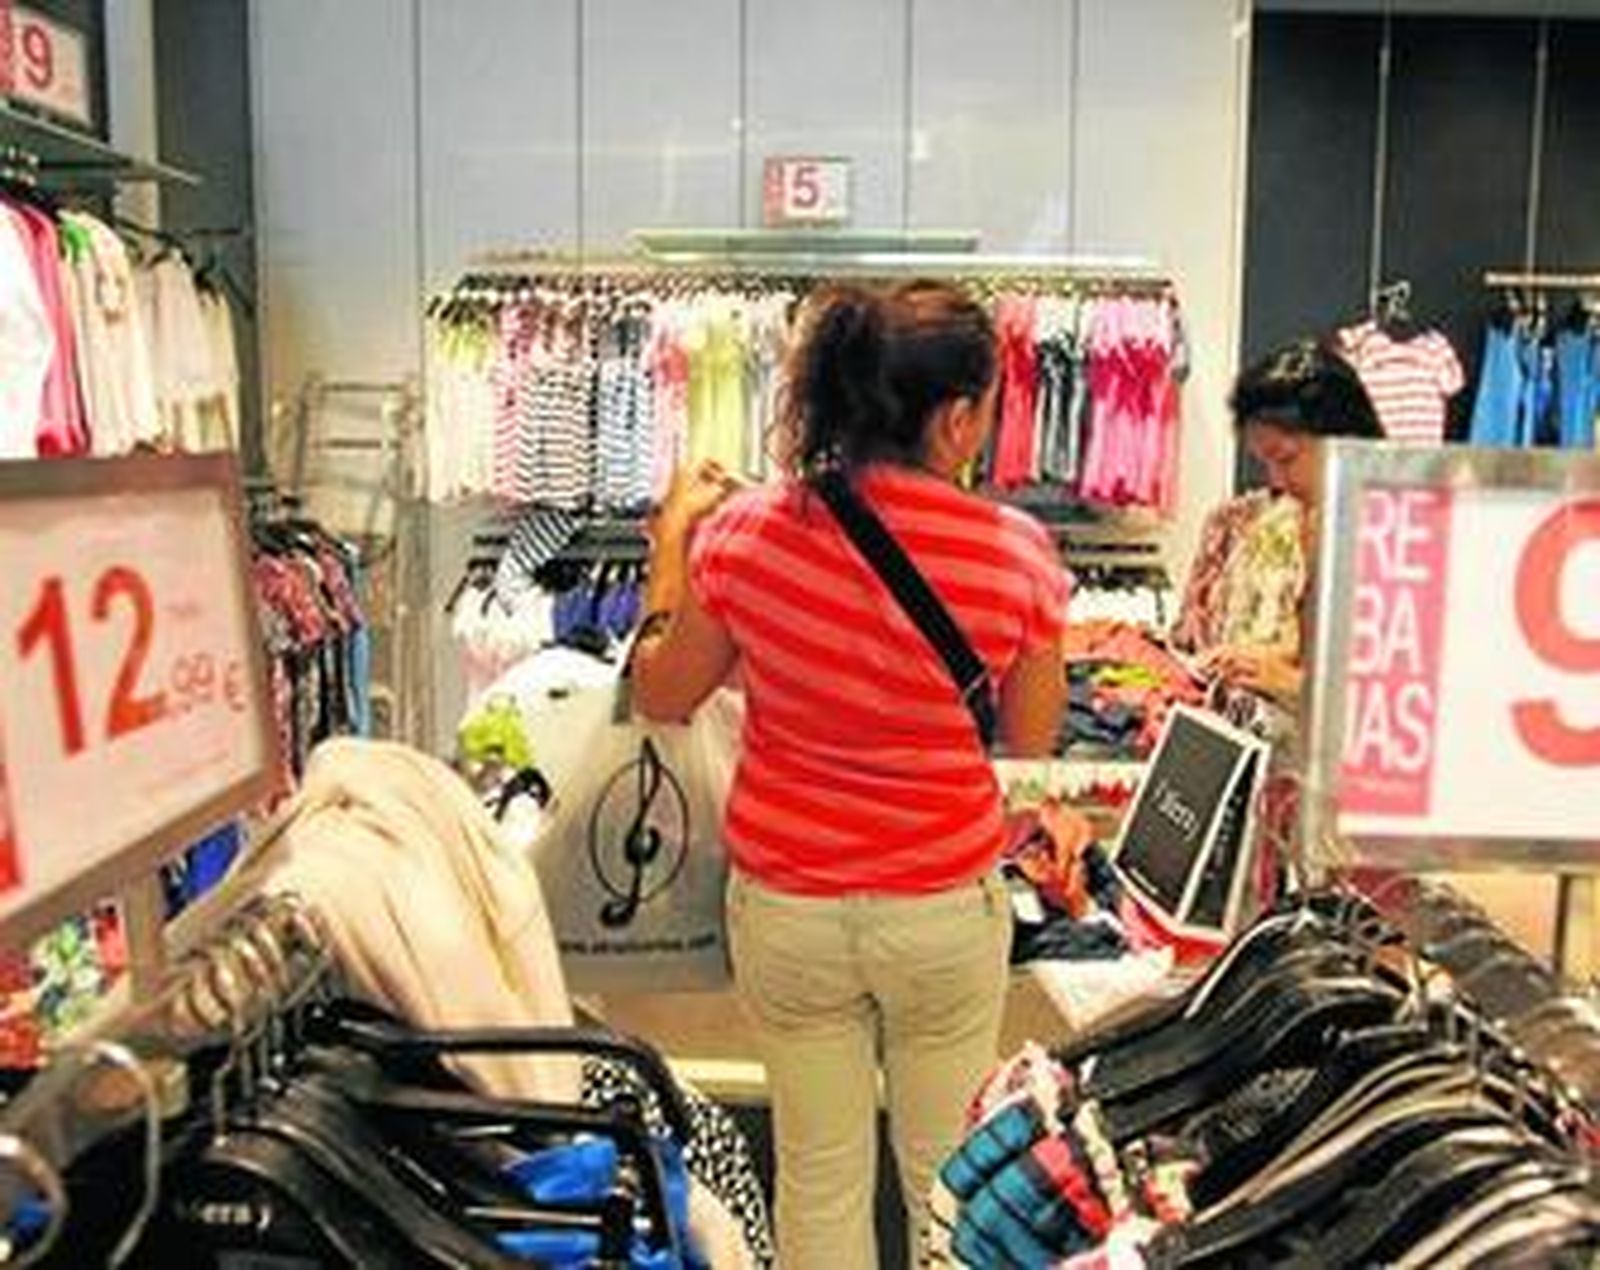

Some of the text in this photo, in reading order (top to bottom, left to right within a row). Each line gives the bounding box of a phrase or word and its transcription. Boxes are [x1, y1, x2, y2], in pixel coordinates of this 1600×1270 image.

[22, 23, 54, 92] 9
[792, 165, 820, 210] 5
[1358, 490, 1436, 582] RE
[1348, 584, 1425, 676] BA
